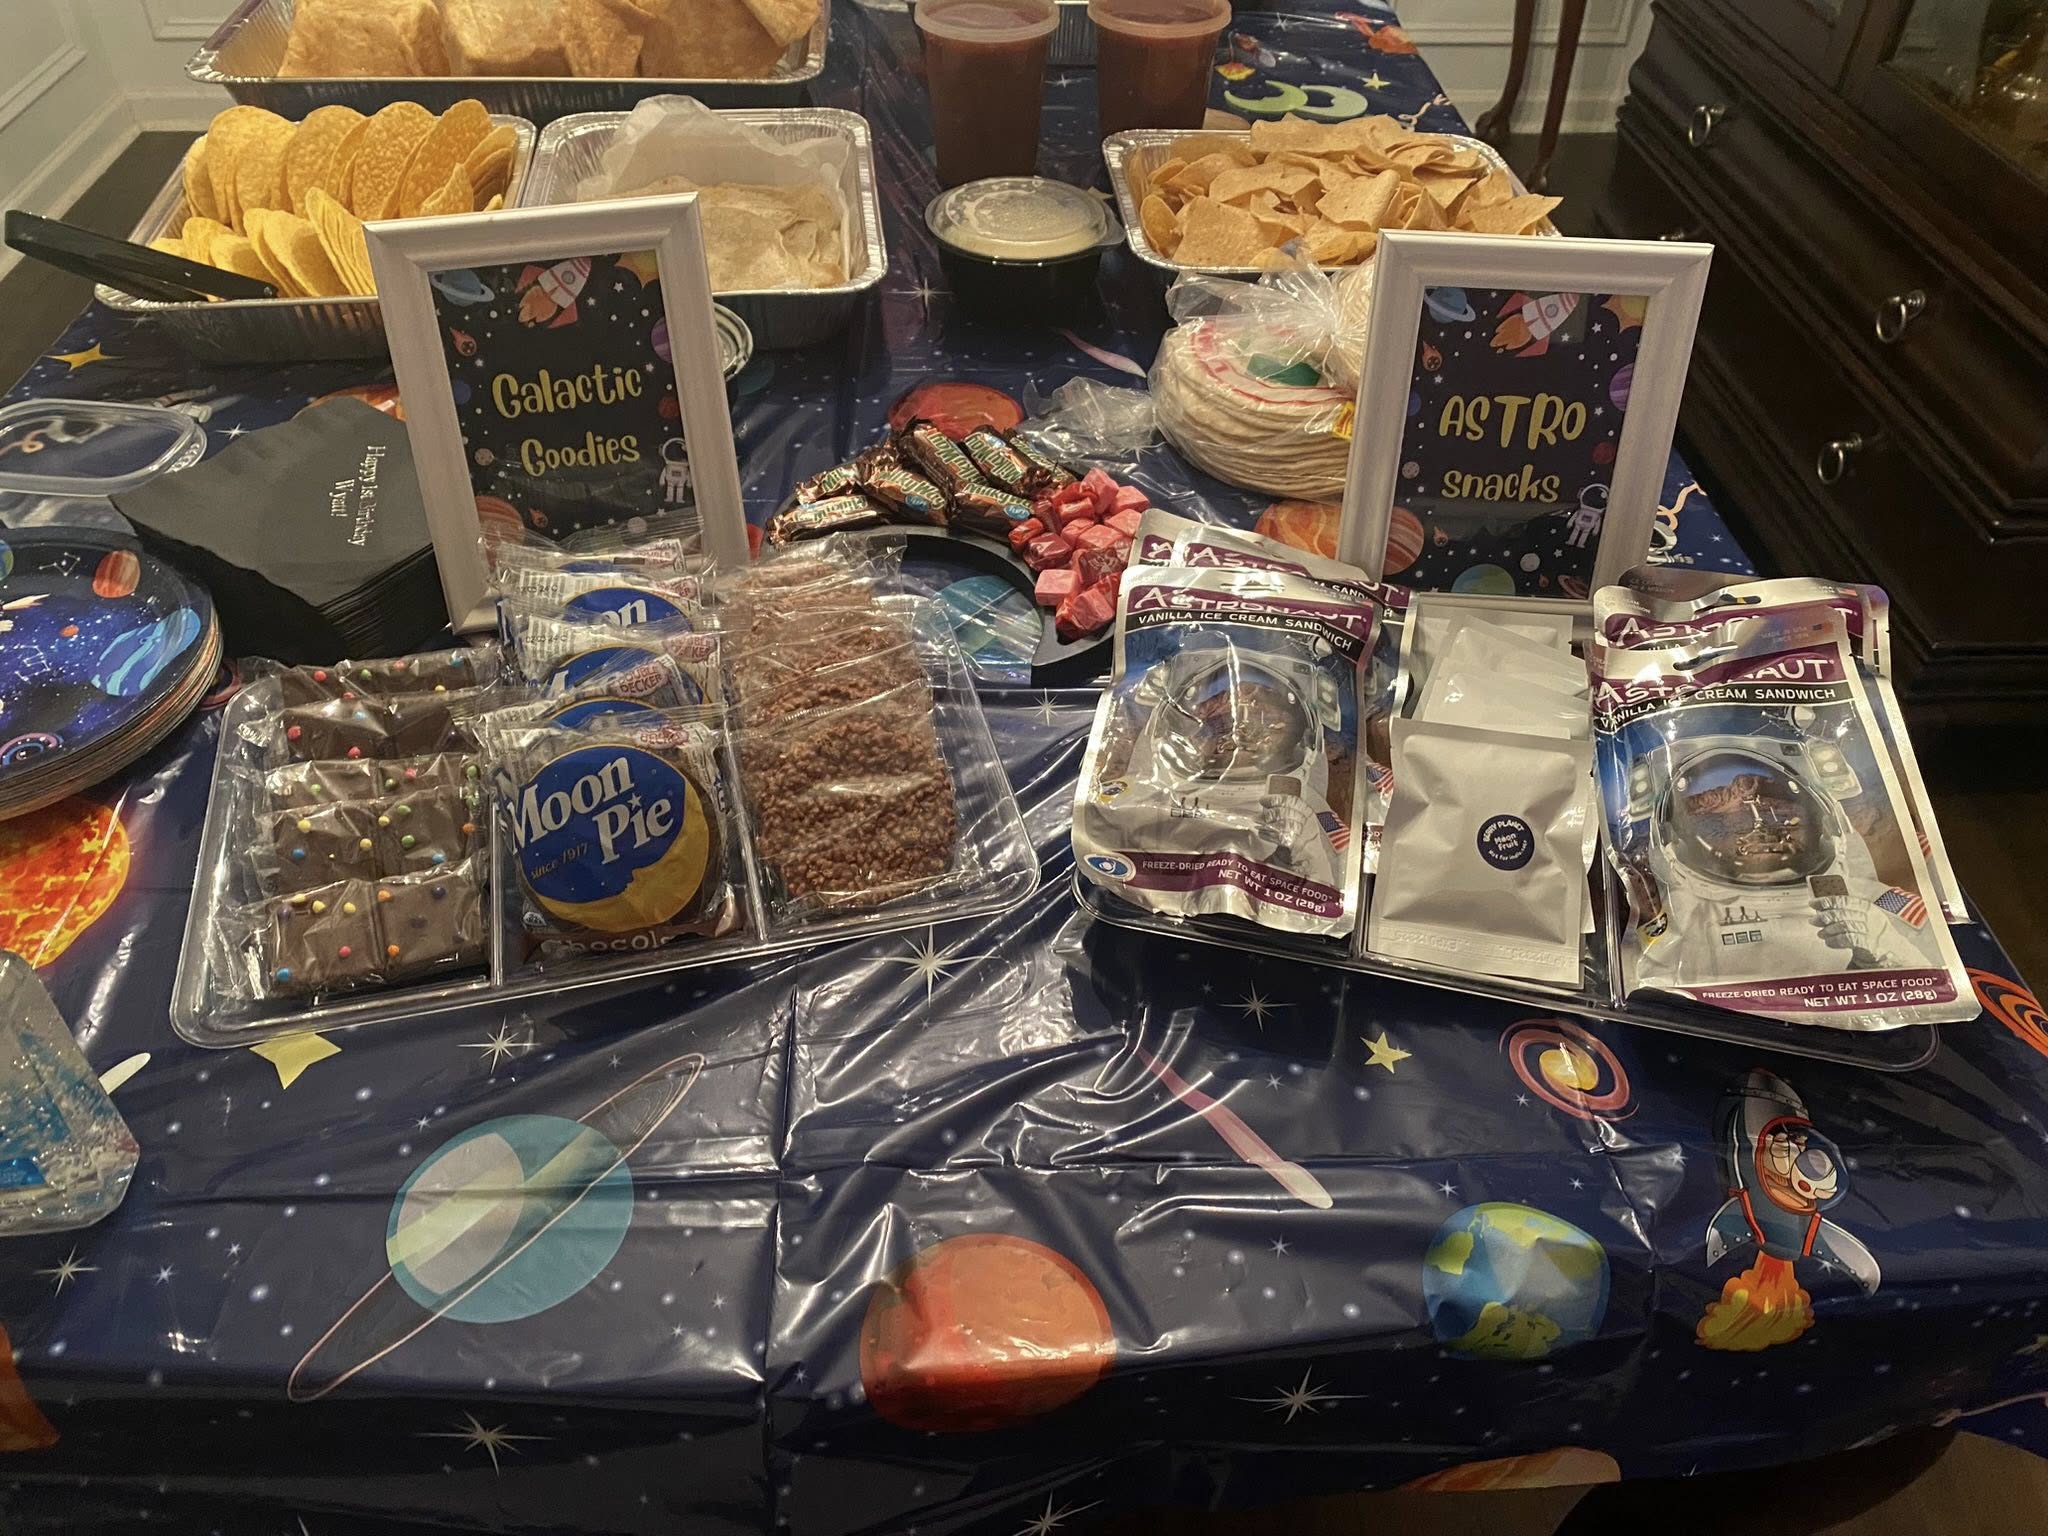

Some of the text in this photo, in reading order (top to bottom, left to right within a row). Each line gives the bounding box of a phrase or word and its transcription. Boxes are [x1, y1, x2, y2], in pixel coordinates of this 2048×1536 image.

[491, 364, 642, 419] Galactic
[1438, 392, 1587, 450] ASTRO
[359, 445, 386, 482] Happy
[520, 431, 641, 477] Goodies
[329, 479, 355, 517] Wyatt!
[1441, 464, 1560, 503] snacks
[1138, 611, 1352, 651] VANILLA ICE CREAM SANDWICH
[619, 673, 663, 693] DECKER
[1694, 688, 1748, 701] CREAM
[1755, 688, 1837, 700] SANDWICH
[507, 757, 635, 856] Moon
[592, 793, 674, 865] Pie
[531, 842, 588, 880] since 1917
[1142, 861, 1205, 871] FREEZE-DRIED
[1206, 859, 1233, 868] READY
[1237, 861, 1248, 872] TO
[1250, 870, 1267, 883] EAT
[1269, 878, 1300, 894] SPACE
[1218, 868, 1241, 881] NET
[1244, 876, 1261, 892] WT
[1264, 889, 1271, 897] 1
[1274, 892, 1293, 904] OZ
[1296, 898, 1326, 914] (28g)
[1702, 978, 1933, 998] FREEZE-DRIED READY TO EAT SPACE FOOD
[1803, 989, 1937, 1008] NET WT 1 OZ (28g)
